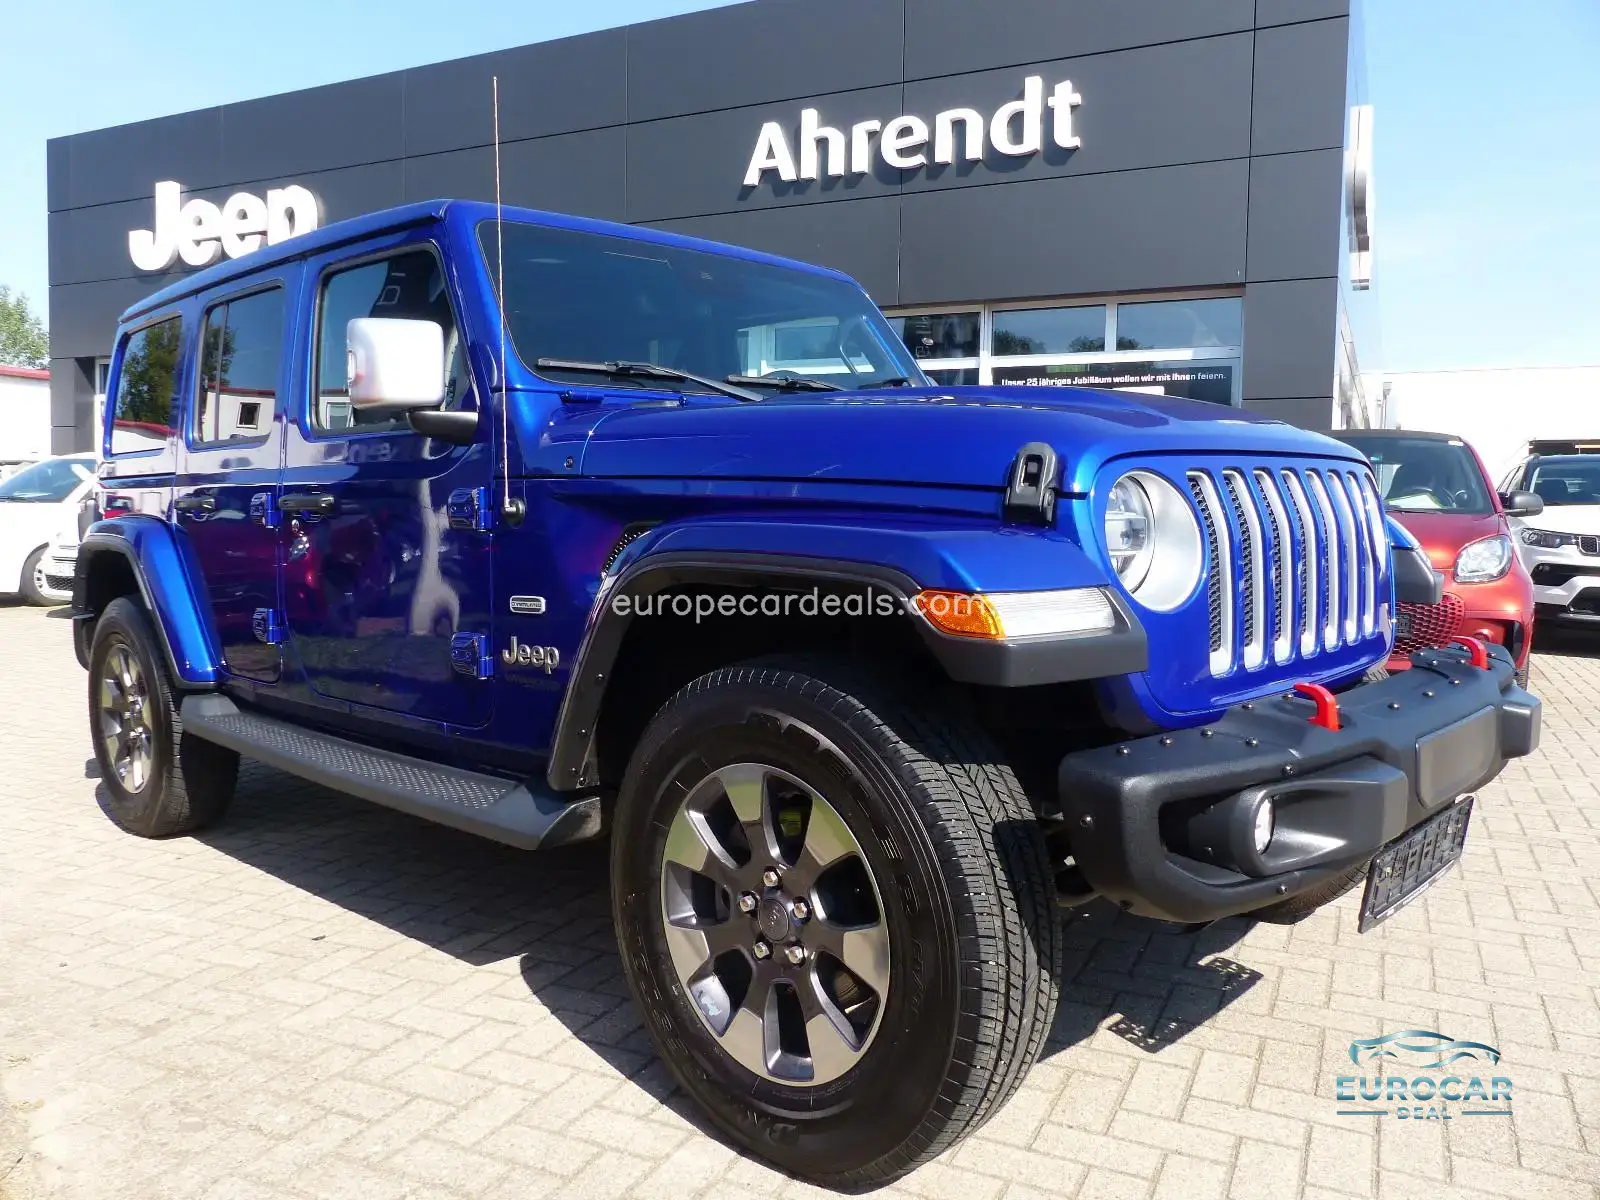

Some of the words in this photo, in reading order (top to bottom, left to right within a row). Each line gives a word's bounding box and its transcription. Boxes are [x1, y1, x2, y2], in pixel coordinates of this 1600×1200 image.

[743, 75, 1082, 187] Ahrendt
[128, 180, 319, 270] Jeep
[1001, 378, 1025, 386] Unser
[1026, 378, 1038, 386] 25
[1072, 376, 1112, 385] Jubiläum
[1112, 374, 1140, 383] wollen
[1140, 373, 1156, 382] wir
[1156, 373, 1171, 381] mit
[1171, 372, 1196, 381] Ihnen
[502, 636, 560, 674] Jeep
